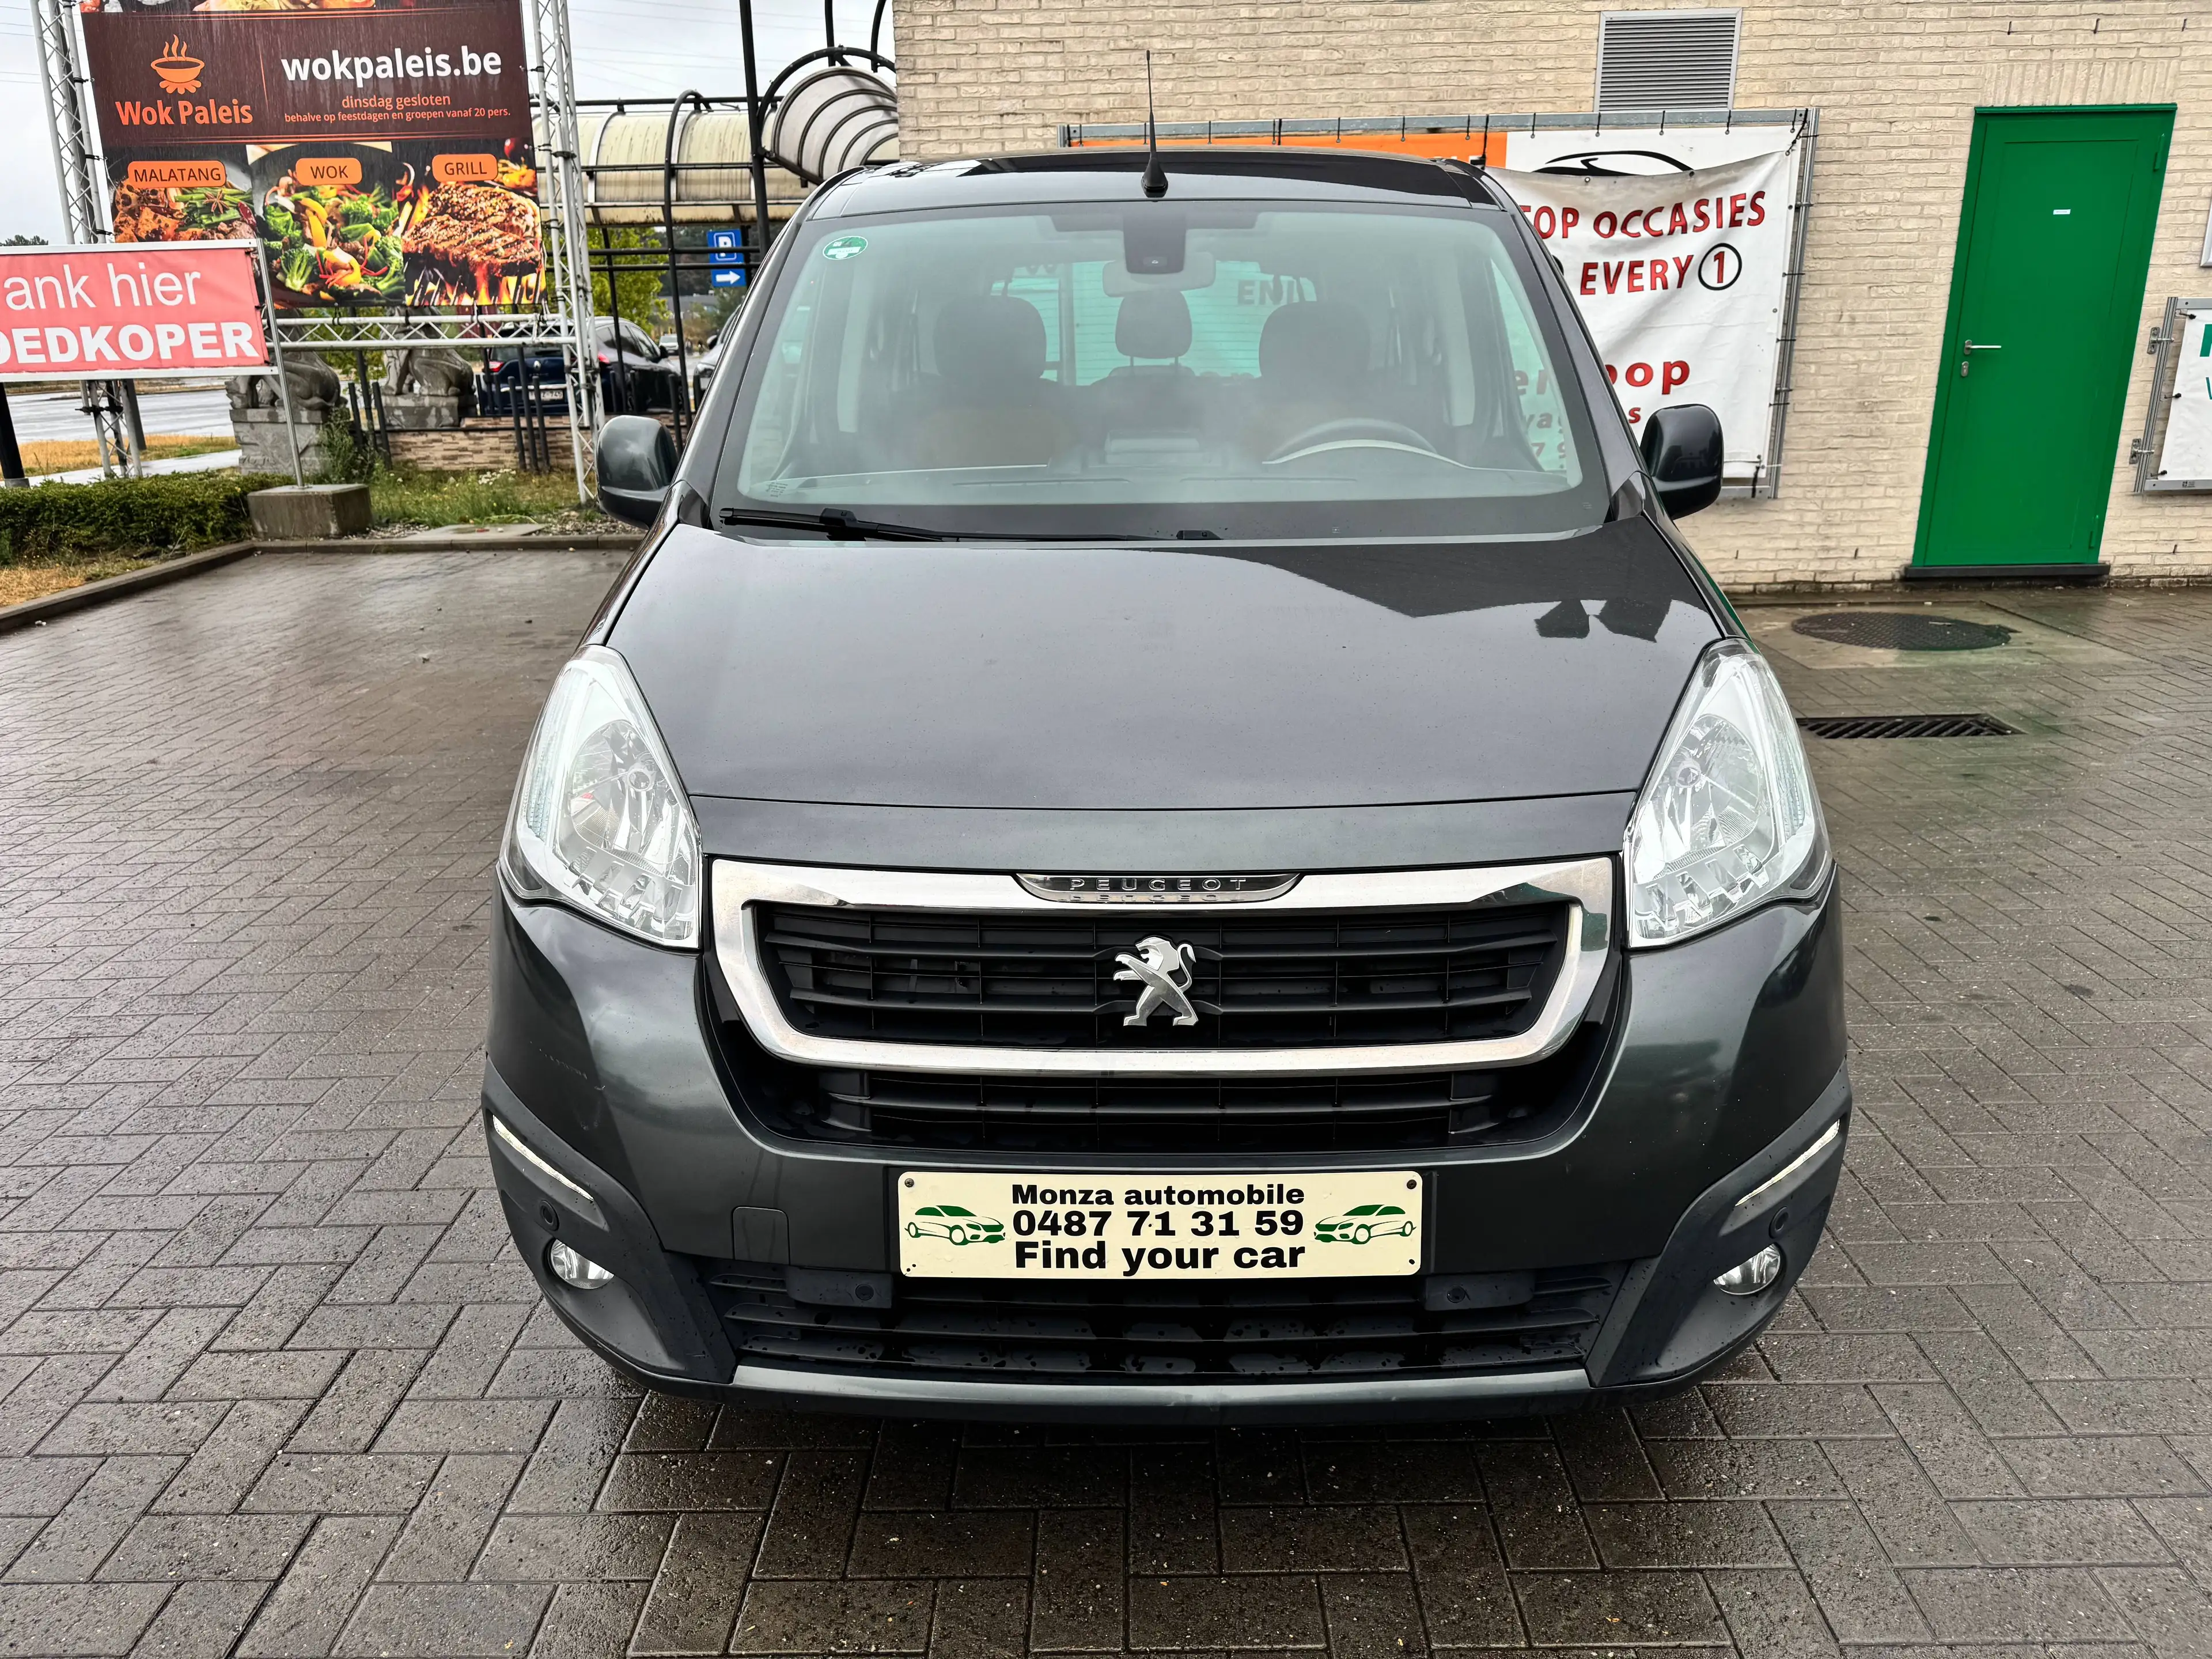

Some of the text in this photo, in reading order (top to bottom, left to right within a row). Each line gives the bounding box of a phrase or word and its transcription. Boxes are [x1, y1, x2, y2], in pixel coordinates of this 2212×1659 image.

[281, 46, 501, 88] wokpaleis.be
[115, 99, 253, 126] Wok Paleis
[342, 94, 450, 110] dinsdag gesloten
[285, 112, 321, 122] behalve
[324, 113, 336, 123] op
[338, 111, 389, 122] feestdagen
[406, 111, 444, 122] groepen
[446, 108, 472, 118] vanaf
[474, 108, 485, 117] 20
[488, 108, 510, 119] pers.
[134, 168, 221, 182] MALATANG
[310, 165, 349, 179] WOK
[444, 161, 487, 176] GRILL
[1593, 191, 1767, 238] OCCASIES
[718, 236, 732, 257] P
[1580, 251, 1725, 296] EVERY 1
[5, 262, 200, 310] ank hier
[1069, 877, 1247, 891] PEUGEOT
[1012, 1184, 1305, 1205] Monza automobile
[1013, 1210, 1304, 1236] 0487 71 31 59
[1016, 1240, 1305, 1277] Find your car
